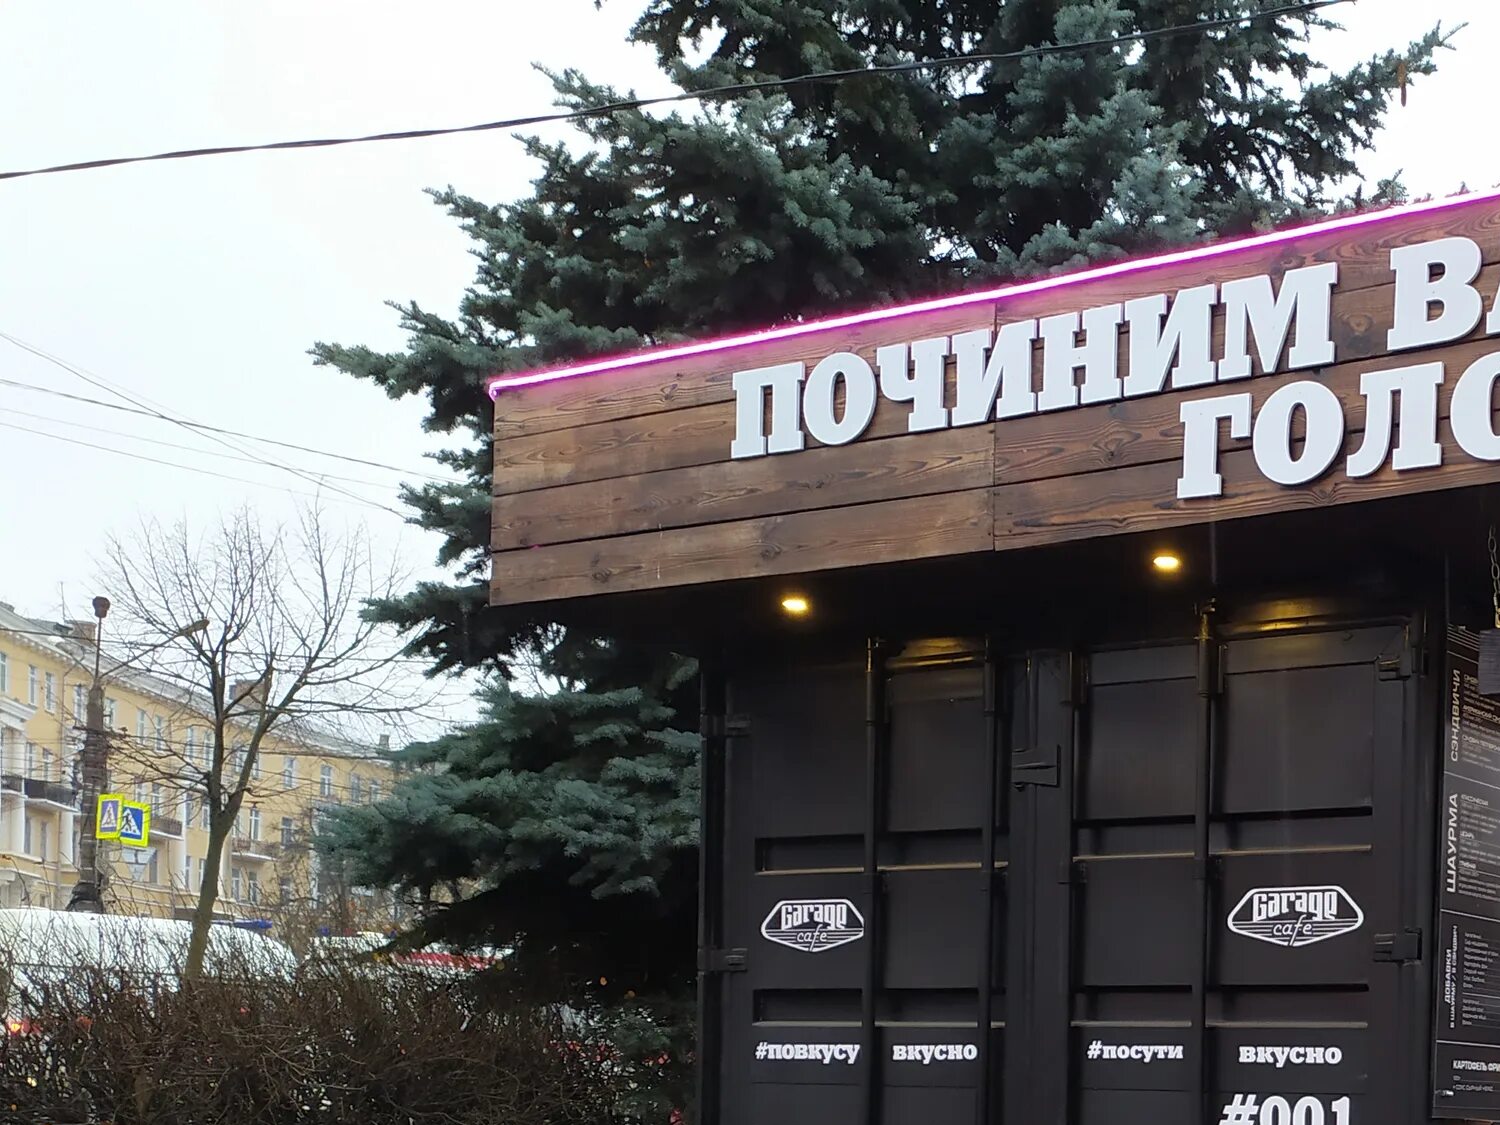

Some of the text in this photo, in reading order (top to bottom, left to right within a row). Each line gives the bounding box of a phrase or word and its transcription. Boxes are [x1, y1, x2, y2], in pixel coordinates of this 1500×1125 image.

[730, 262, 1337, 460] ПОЧИНИМ
[1450, 668, 1461, 762] СЭНДВИЧИ
[1446, 793, 1458, 893] ШАУРМА
[780, 903, 848, 930] Garage
[1252, 891, 1338, 923] Garage
[796, 923, 828, 951] cafe
[1272, 914, 1313, 946] cafe
[1444, 949, 1452, 1004] ДОБАВКИ
[892, 1044, 979, 1065] вкусно
[1238, 1046, 1343, 1068] вкусно
